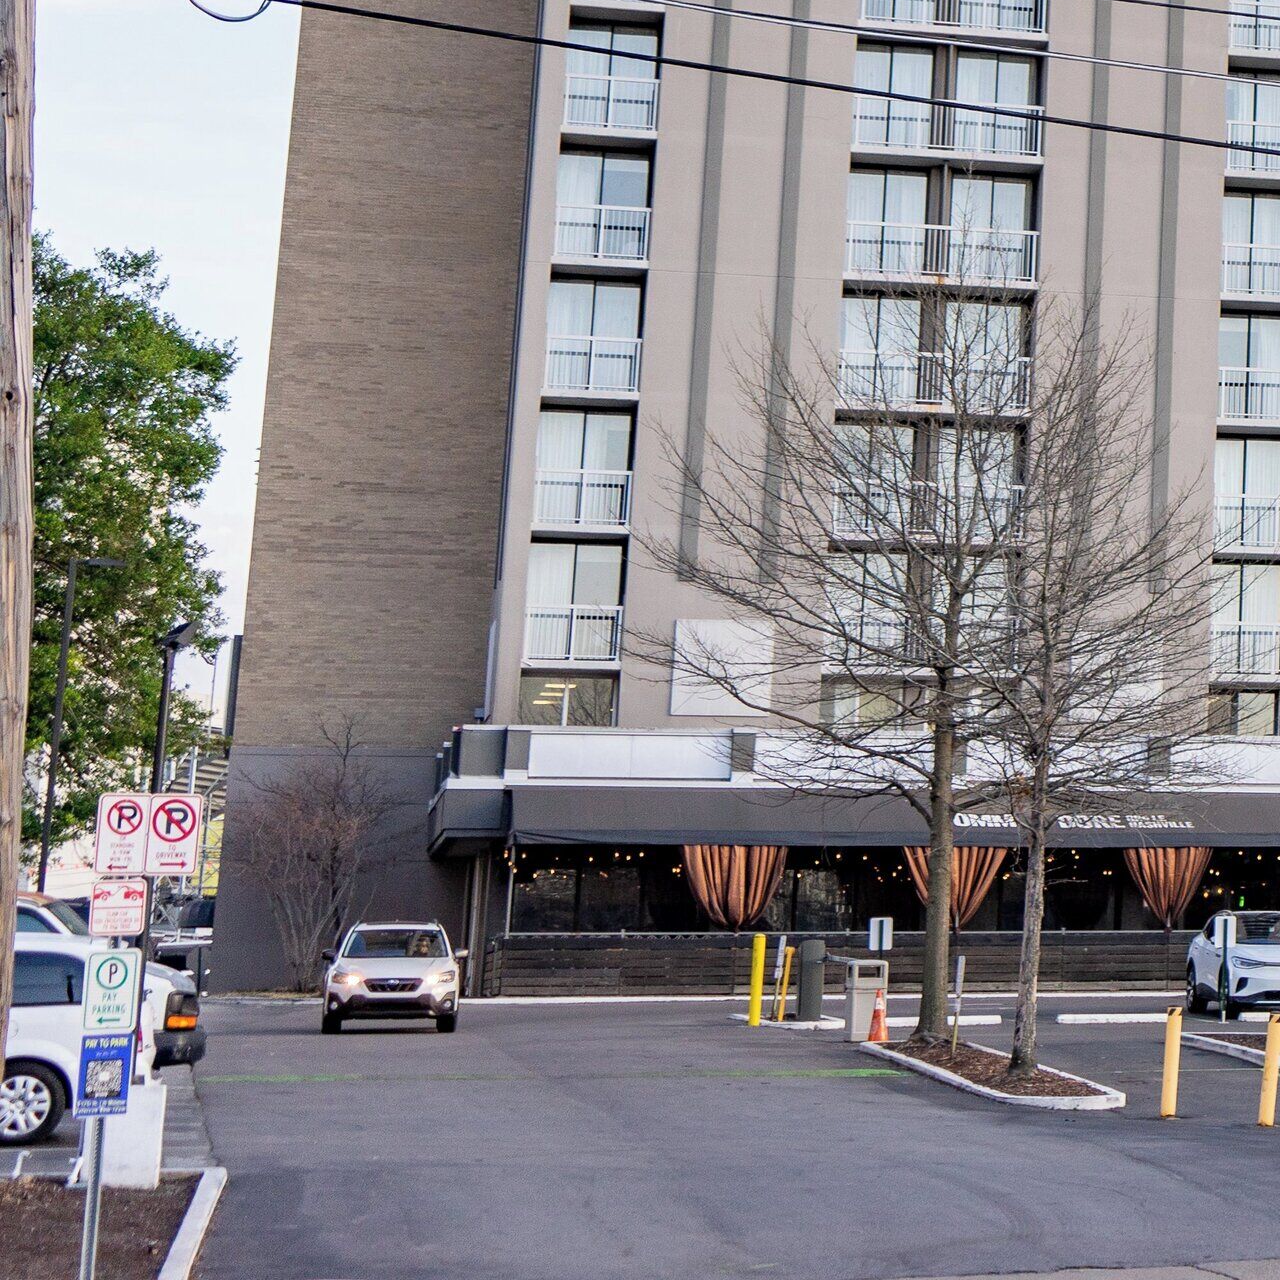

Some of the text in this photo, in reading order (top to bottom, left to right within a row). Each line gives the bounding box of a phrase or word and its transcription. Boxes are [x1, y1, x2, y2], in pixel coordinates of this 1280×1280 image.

[155, 851, 187, 859] DRIVEWAY
[102, 993, 117, 1002] PAY
[92, 1004, 126, 1015] PARKING
[110, 1037, 129, 1047] PARK
